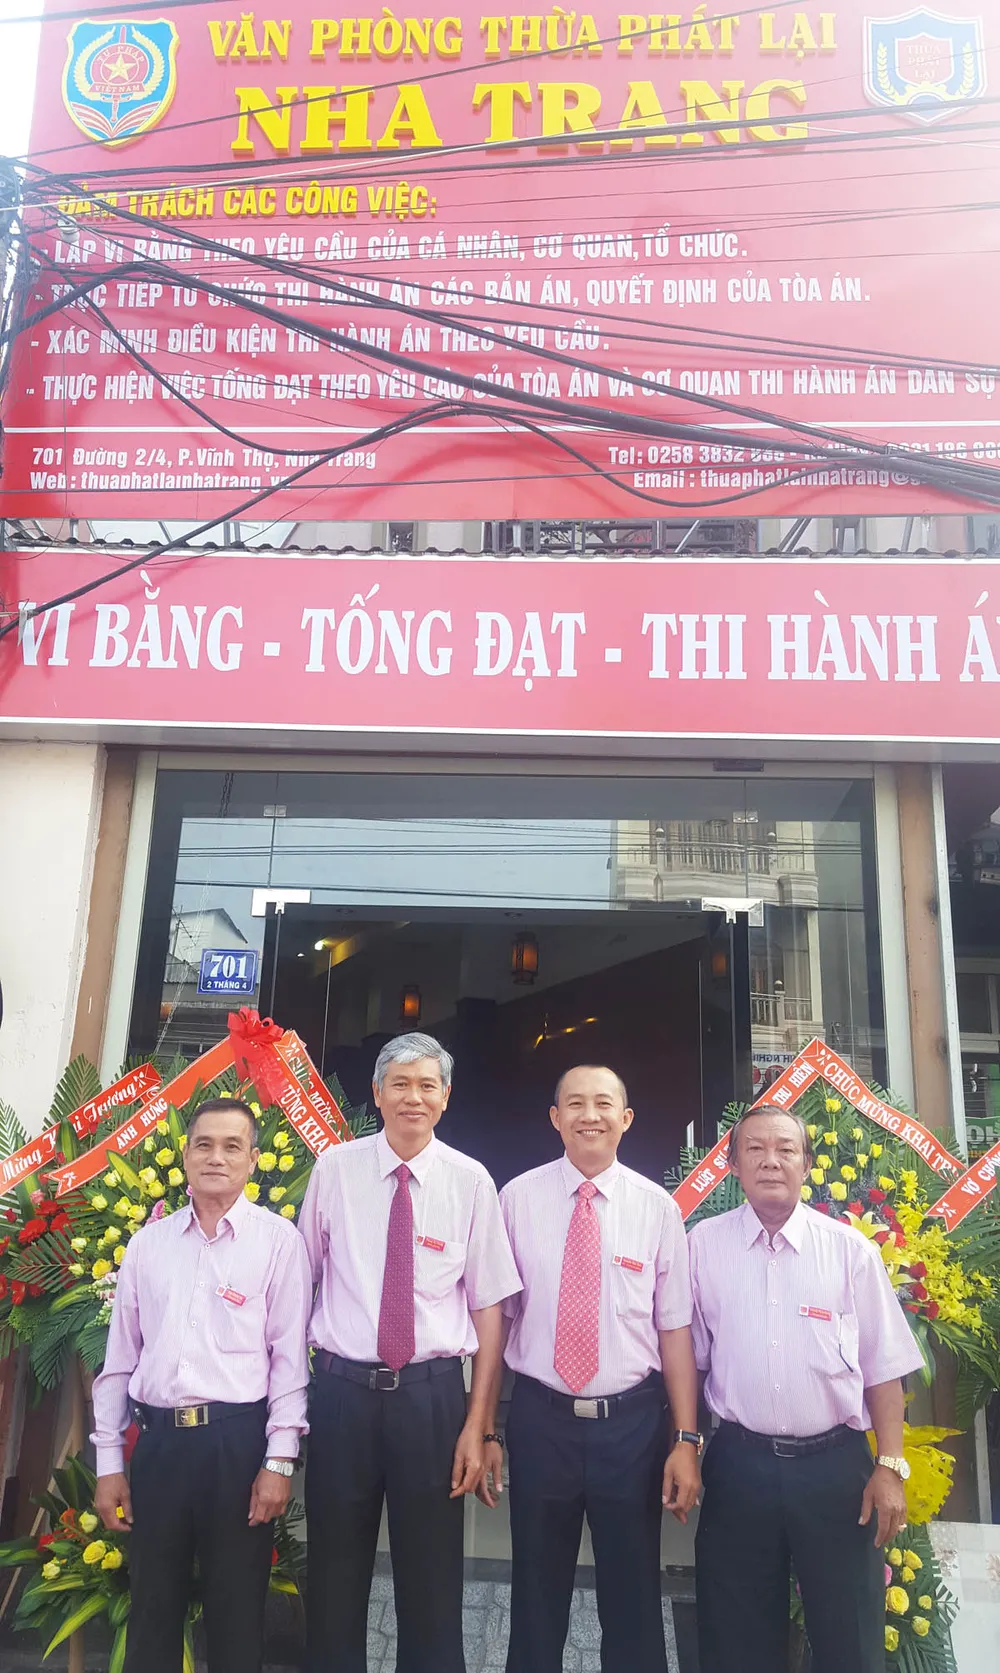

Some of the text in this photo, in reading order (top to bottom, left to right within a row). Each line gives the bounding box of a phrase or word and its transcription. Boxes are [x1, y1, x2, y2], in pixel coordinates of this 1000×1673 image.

[207, 4, 837, 60] VĂN PHÒNG THỪA PHÁT LẠI
[230, 79, 808, 154] NHA TRANG
[128, 183, 214, 217] TRÁCH
[224, 183, 276, 216] CÁC
[286, 180, 357, 217] CÔNG
[367, 181, 436, 220] VIỆC:
[106, 239, 125, 263] VI
[133, 230, 192, 262] BẰNG
[204, 237, 255, 262] THEO
[265, 233, 303, 260] YÊU
[315, 229, 357, 260] CẦU
[367, 229, 410, 260] CỦA
[418, 231, 446, 260] CÁ
[457, 230, 525, 260] NHÂN,
[533, 231, 564, 259] CƠ
[679, 229, 747, 257] CHỨC.
[274, 282, 308, 306] THI
[320, 277, 379, 305] HÀNH
[389, 277, 420, 305] ÁN
[430, 276, 474, 305] CÁC
[485, 271, 530, 305] BẢN
[540, 273, 579, 307] ÁN,
[586, 274, 654, 305] QUYẾT
[663, 279, 717, 307] ĐỊNH
[728, 270, 772, 302] CỦA
[779, 272, 822, 302] TÒA
[830, 272, 870, 302] ÁN.
[46, 324, 90, 354] XÁC
[100, 328, 157, 354] MINH
[168, 322, 216, 352] ĐIỀU
[227, 323, 276, 358] KIỆN
[286, 327, 319, 352] THI
[330, 323, 390, 352] HÀNH
[400, 324, 430, 352] ÁN
[440, 327, 494, 352] THEO
[554, 318, 609, 351] CẦU.
[43, 373, 97, 404] THỰC
[105, 371, 152, 404] HIỆN
[160, 371, 205, 404] VIỆC
[211, 367, 265, 399] TỐNG
[273, 374, 313, 405] ĐẠT
[319, 374, 370, 399] THEO
[376, 369, 415, 399] YÊU
[473, 364, 514, 398] CỦA
[521, 367, 560, 398] TÒA
[568, 367, 599, 398] ÁN
[608, 366, 635, 398] VÀ
[641, 368, 672, 397] CƠ
[680, 370, 740, 396] QUAN
[748, 370, 784, 395] THI
[793, 365, 856, 395] HÀNH
[864, 365, 896, 394] ÁN
[32, 447, 63, 466] 701
[72, 447, 128, 468] Đường
[135, 448, 172, 468] 2/4,
[242, 449, 279, 472] Thọ,
[647, 446, 693, 465] 0258
[699, 445, 744, 465] 3832
[18, 602, 75, 667] VI
[89, 570, 243, 672] BẰNG
[301, 584, 453, 676] TỐNG
[473, 610, 586, 692] ĐẠT
[641, 612, 747, 681] THI
[767, 589, 940, 682] HÀNH
[960, 590, 1000, 682] Á
[210, 954, 247, 979] 701
[214, 979, 239, 989] THÁNG
[281, 1084, 307, 1123] ỪNG
[772, 1084, 792, 1105] THU
[824, 1062, 860, 1100] CHÚC
[857, 1094, 901, 1131] MỪNG
[900, 1123, 935, 1161] KHAI
[116, 1124, 138, 1150] ANH
